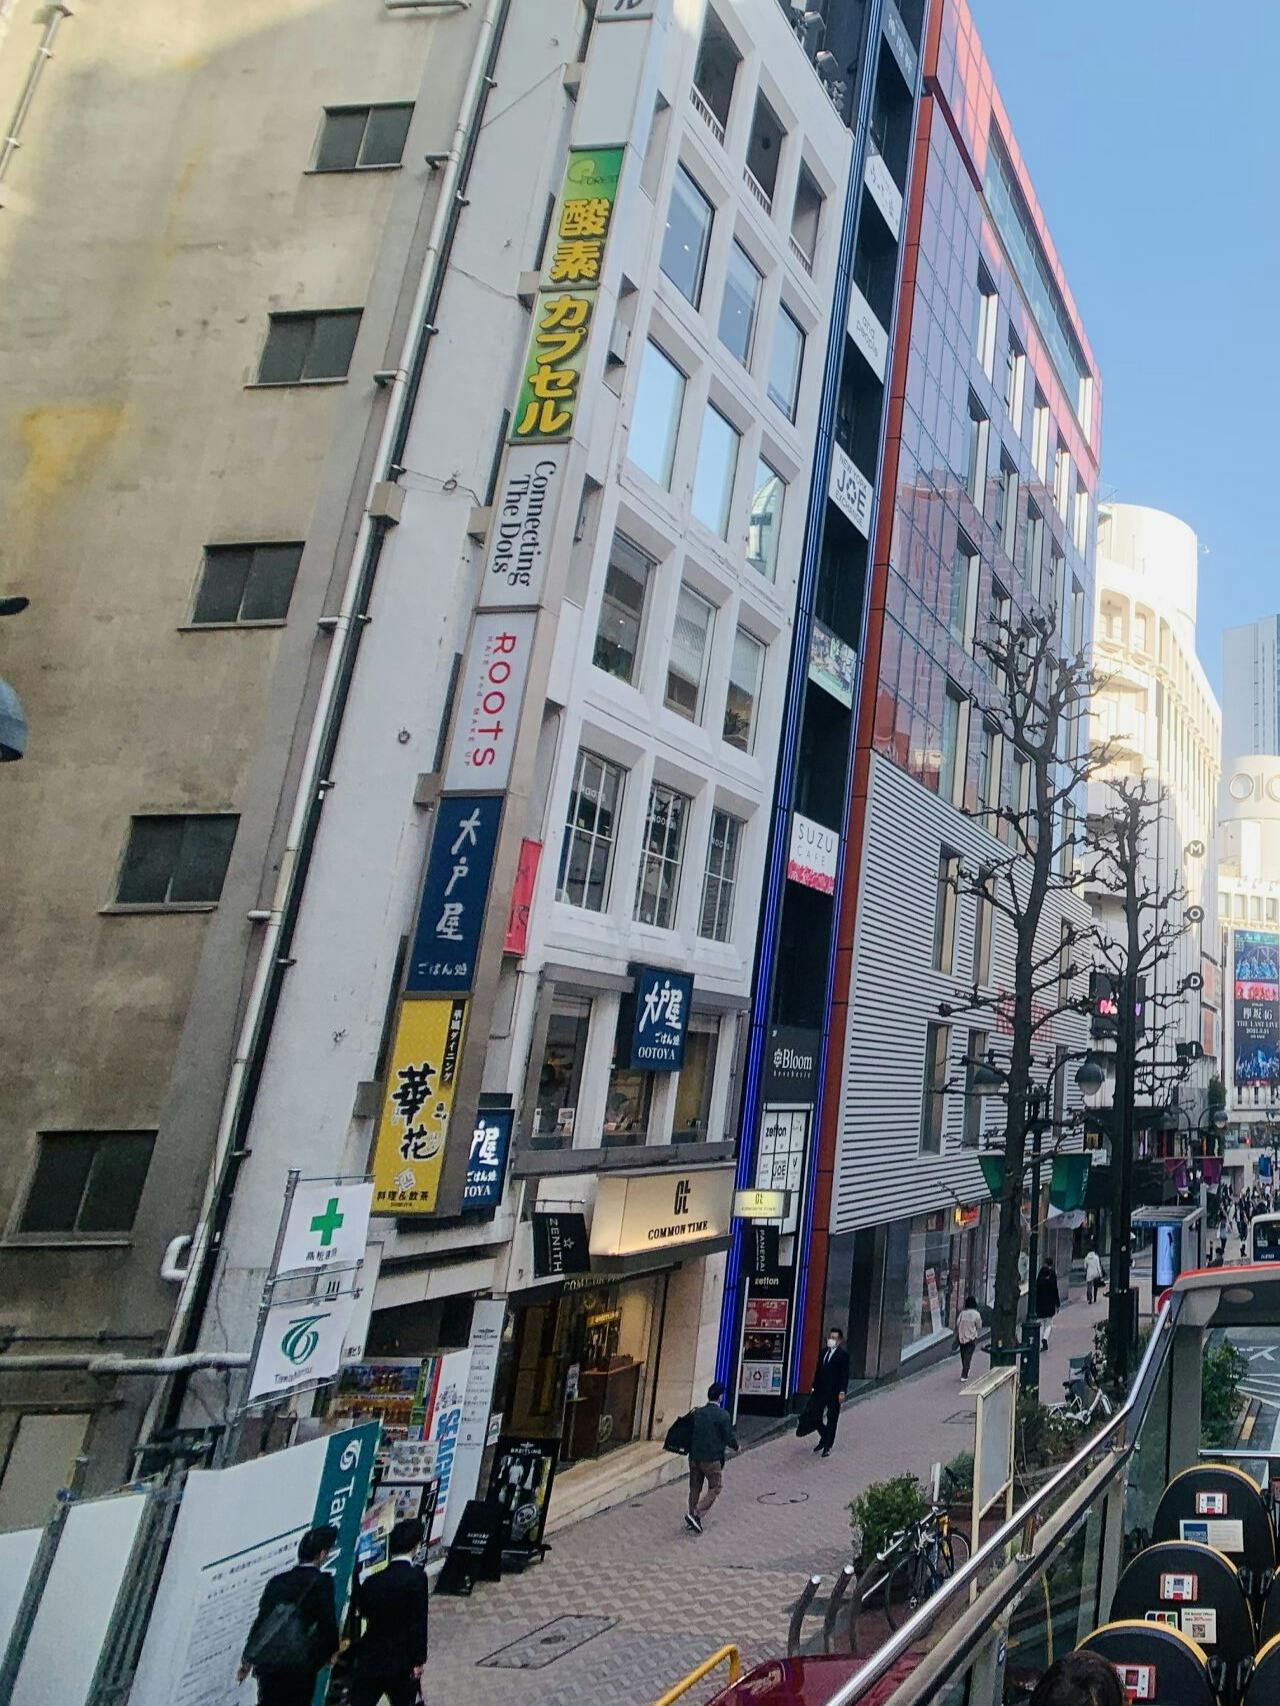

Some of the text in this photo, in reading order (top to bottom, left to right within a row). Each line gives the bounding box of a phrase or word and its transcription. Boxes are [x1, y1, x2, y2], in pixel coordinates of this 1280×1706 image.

[516, 197, 610, 437] 酸素カプセル
[491, 474, 531, 575] The Dots
[507, 459, 557, 587] Connecting
[472, 632, 517, 767] ROOTS
[798, 822, 834, 853] SUZU
[435, 807, 480, 942] 大戸屋
[417, 960, 468, 978] ごはん処
[638, 978, 684, 1033] 大戸屋
[637, 1046, 676, 1060] OOTOYA
[782, 1049, 813, 1070] Bloom
[468, 1119, 501, 1166] 戸屋
[464, 1185, 492, 1199] TOYA
[548, 1218, 563, 1273] ZENITH
[647, 1220, 708, 1241] COMMON TIME
